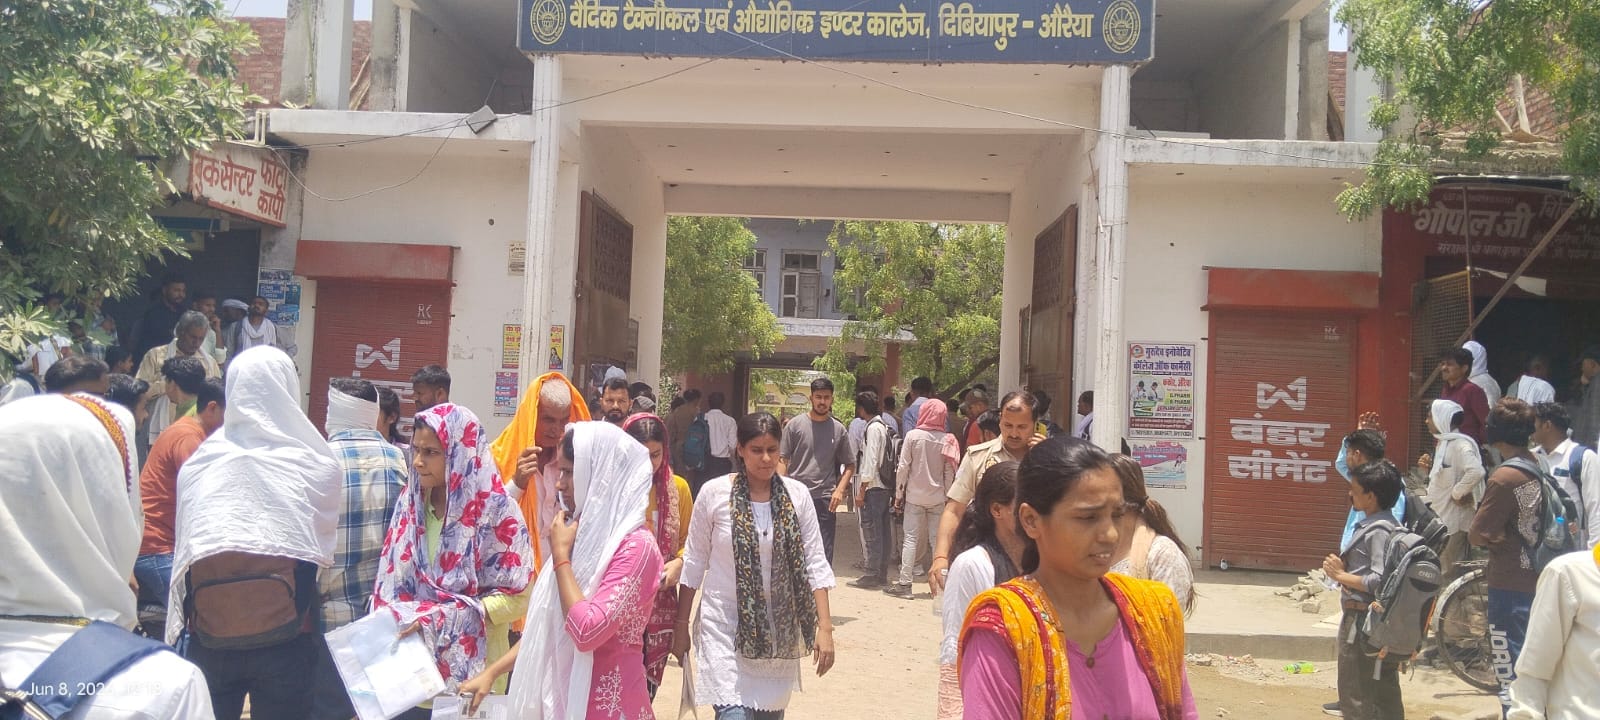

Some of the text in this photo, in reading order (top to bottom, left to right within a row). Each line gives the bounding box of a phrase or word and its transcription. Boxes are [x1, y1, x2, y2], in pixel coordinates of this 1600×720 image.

[570, 0, 619, 29] वैदिक
[705, 0, 732, 33] एवं
[733, 0, 816, 34] औद्योगिक
[819, 10, 865, 39] इण्टर
[938, 2, 1020, 51] दिबियापुर
[1038, 3, 1094, 39] औरैया
[1414, 202, 1499, 236] गोपाल
[1230, 412, 1330, 447] वंडर
[1228, 450, 1331, 483] सीमेंट
